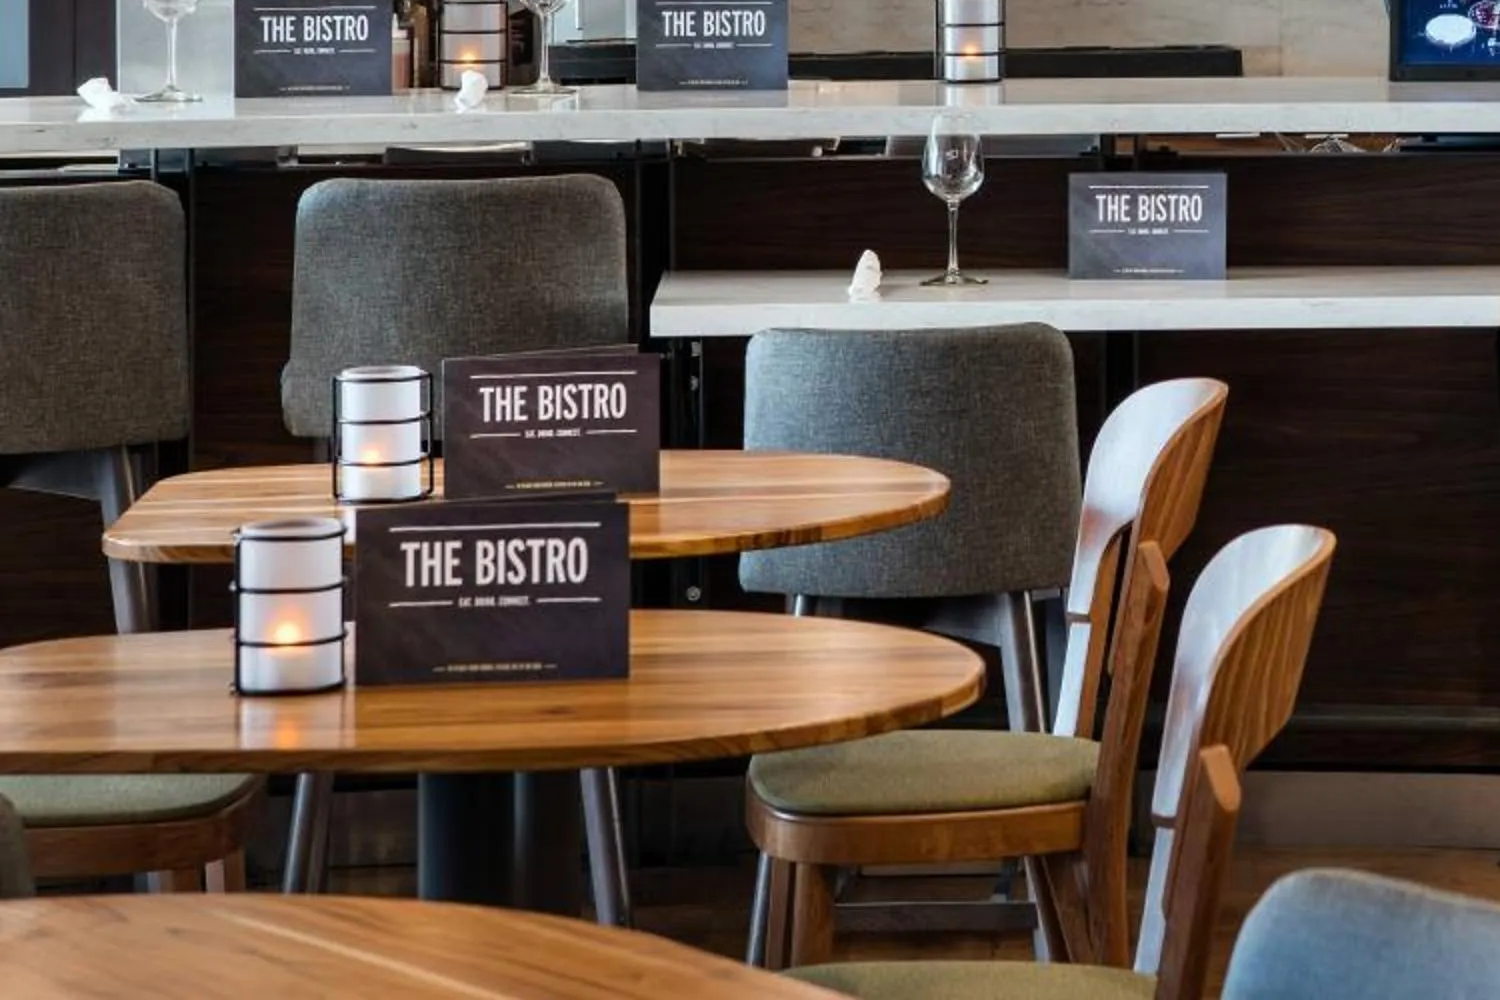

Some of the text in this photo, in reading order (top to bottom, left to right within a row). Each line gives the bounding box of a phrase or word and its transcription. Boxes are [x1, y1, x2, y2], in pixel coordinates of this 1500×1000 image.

[259, 15, 369, 43] THE BISTRO
[661, 10, 766, 37] THE BISTRO
[1095, 195, 1202, 222] THE BISTRO
[479, 383, 627, 423] THE BISTRO
[400, 537, 589, 588] THE BISTRO
